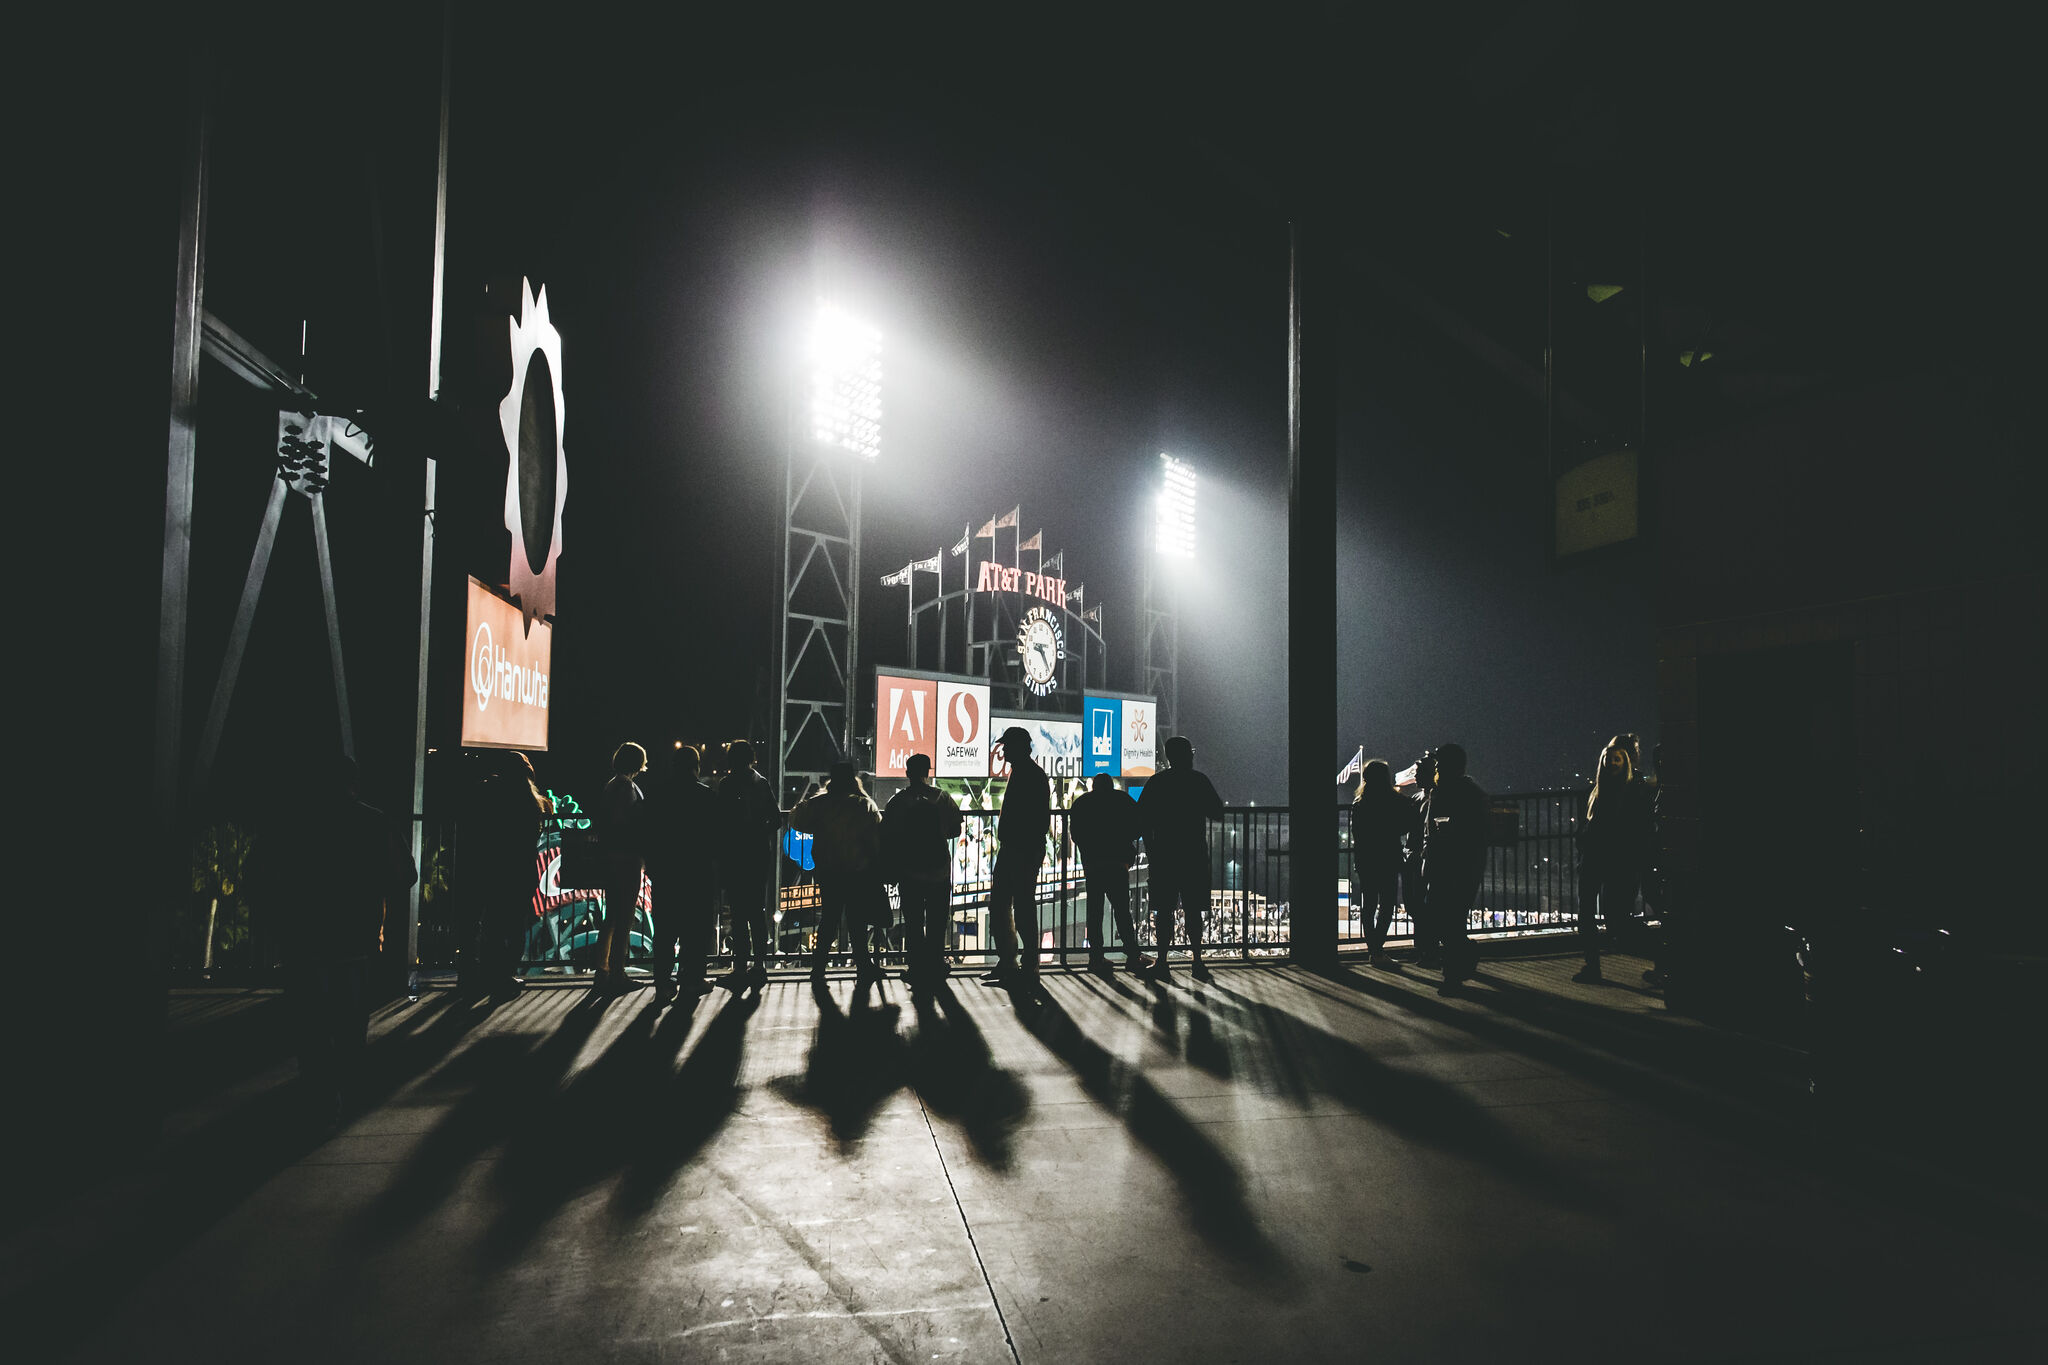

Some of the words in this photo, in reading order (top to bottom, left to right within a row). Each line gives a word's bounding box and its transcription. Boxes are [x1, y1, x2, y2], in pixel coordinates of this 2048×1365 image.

[976, 561, 1021, 593] AT&T
[1024, 571, 1067, 610] PARK
[1017, 619, 1033, 655] SAN
[1027, 606, 1066, 660] FRANCISCO
[494, 644, 549, 709] Hanwha
[1025, 674, 1058, 697] GIANTS
[889, 748, 914, 769] Ado
[946, 745, 979, 758] SAFEWAY
[1123, 748, 1139, 759] Dignity
[1139, 748, 1154, 758] Health
[1043, 755, 1083, 777] LIGHT
